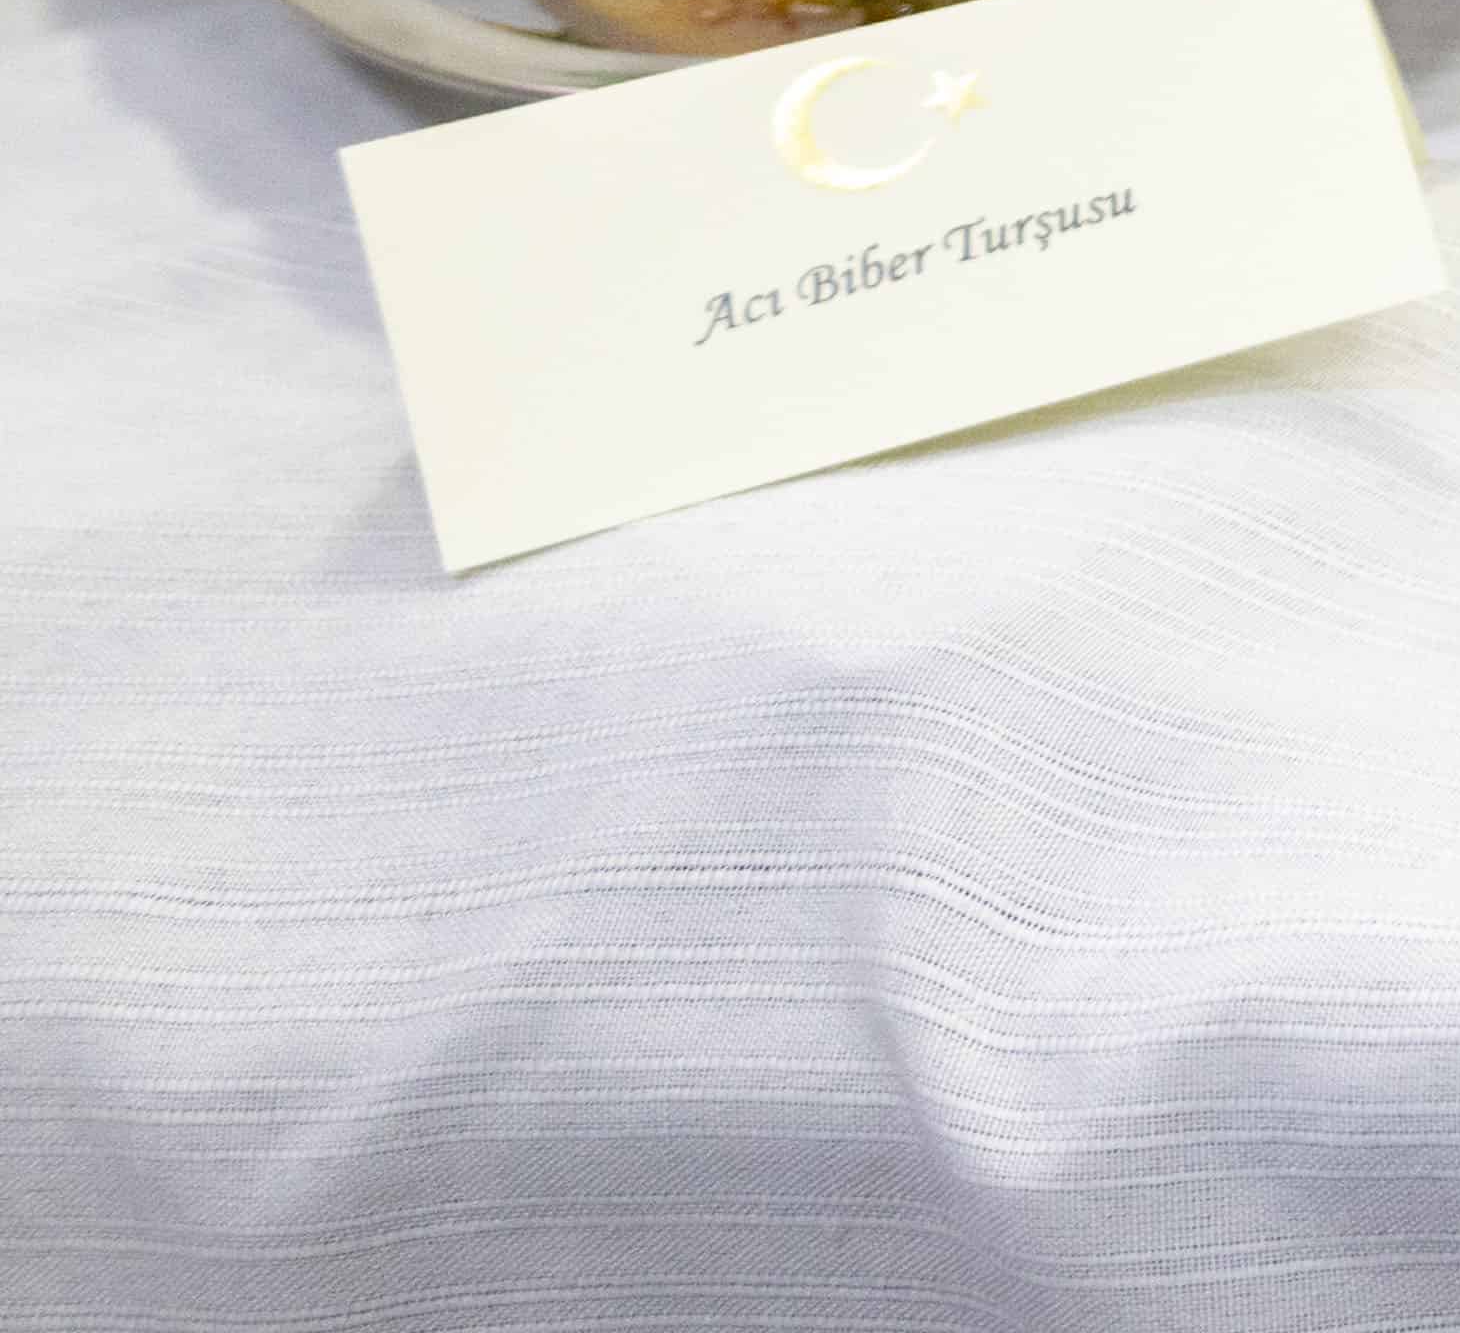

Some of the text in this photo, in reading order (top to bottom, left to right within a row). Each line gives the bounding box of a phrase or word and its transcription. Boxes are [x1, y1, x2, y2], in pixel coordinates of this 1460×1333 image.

[694, 186, 1138, 346] Acı Biber Turşusu
